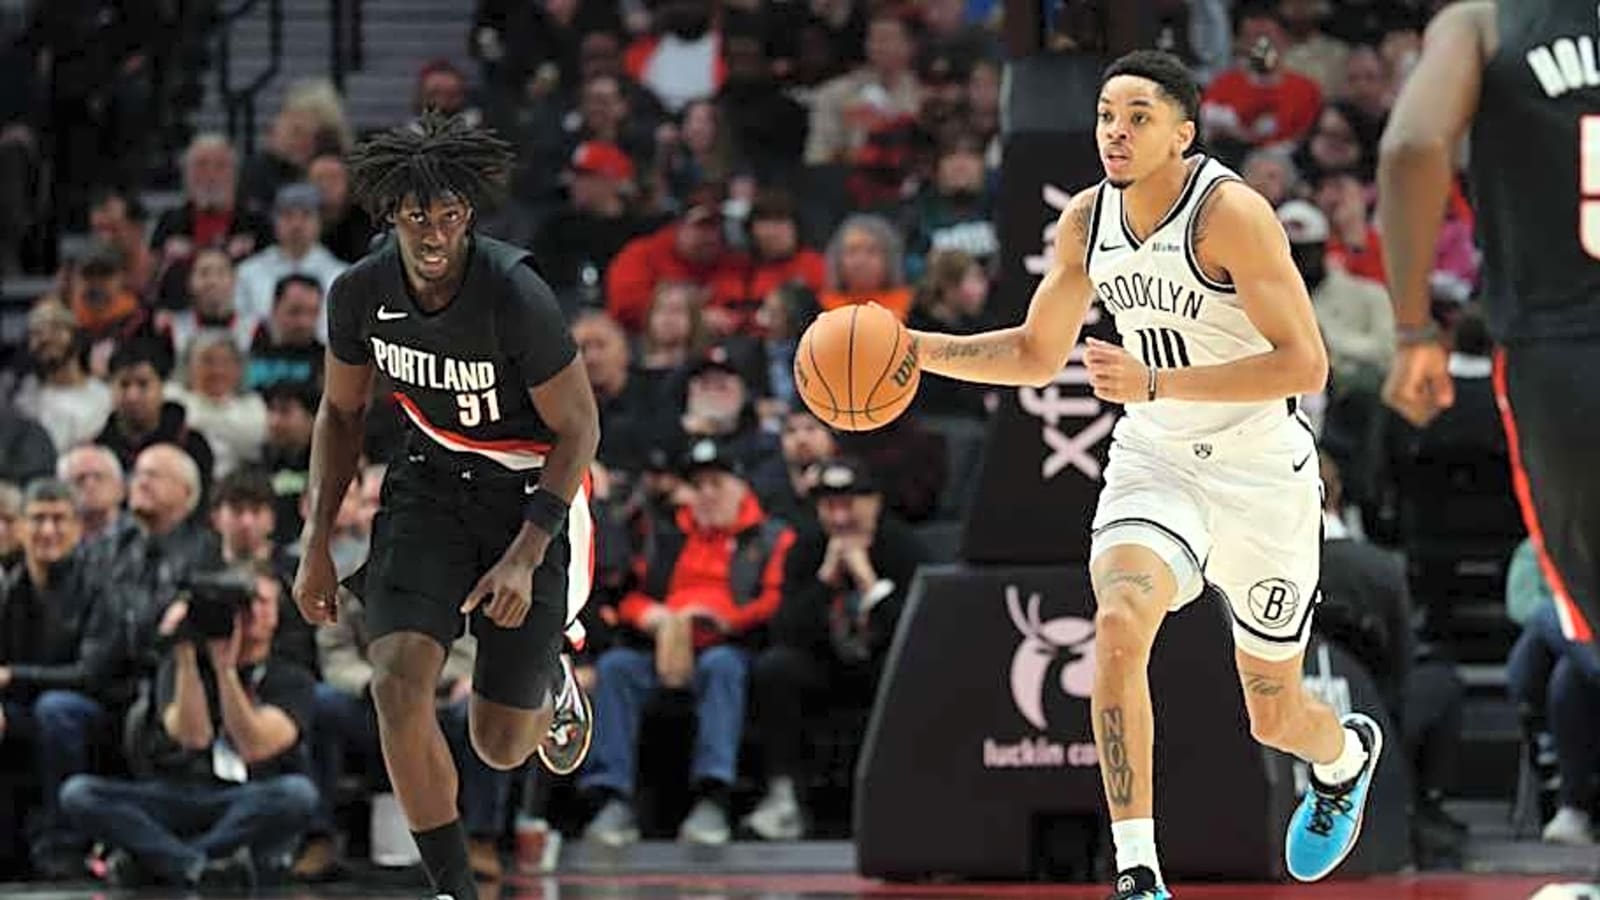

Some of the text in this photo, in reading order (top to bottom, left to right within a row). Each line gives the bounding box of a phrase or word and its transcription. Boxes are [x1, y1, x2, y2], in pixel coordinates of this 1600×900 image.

[1097, 272, 1204, 319] ROOKLYN
[370, 336, 496, 392] PORTLAND
[456, 388, 500, 427] 91
[983, 738, 1064, 767] luckin
[1101, 707, 1133, 806] NOW
